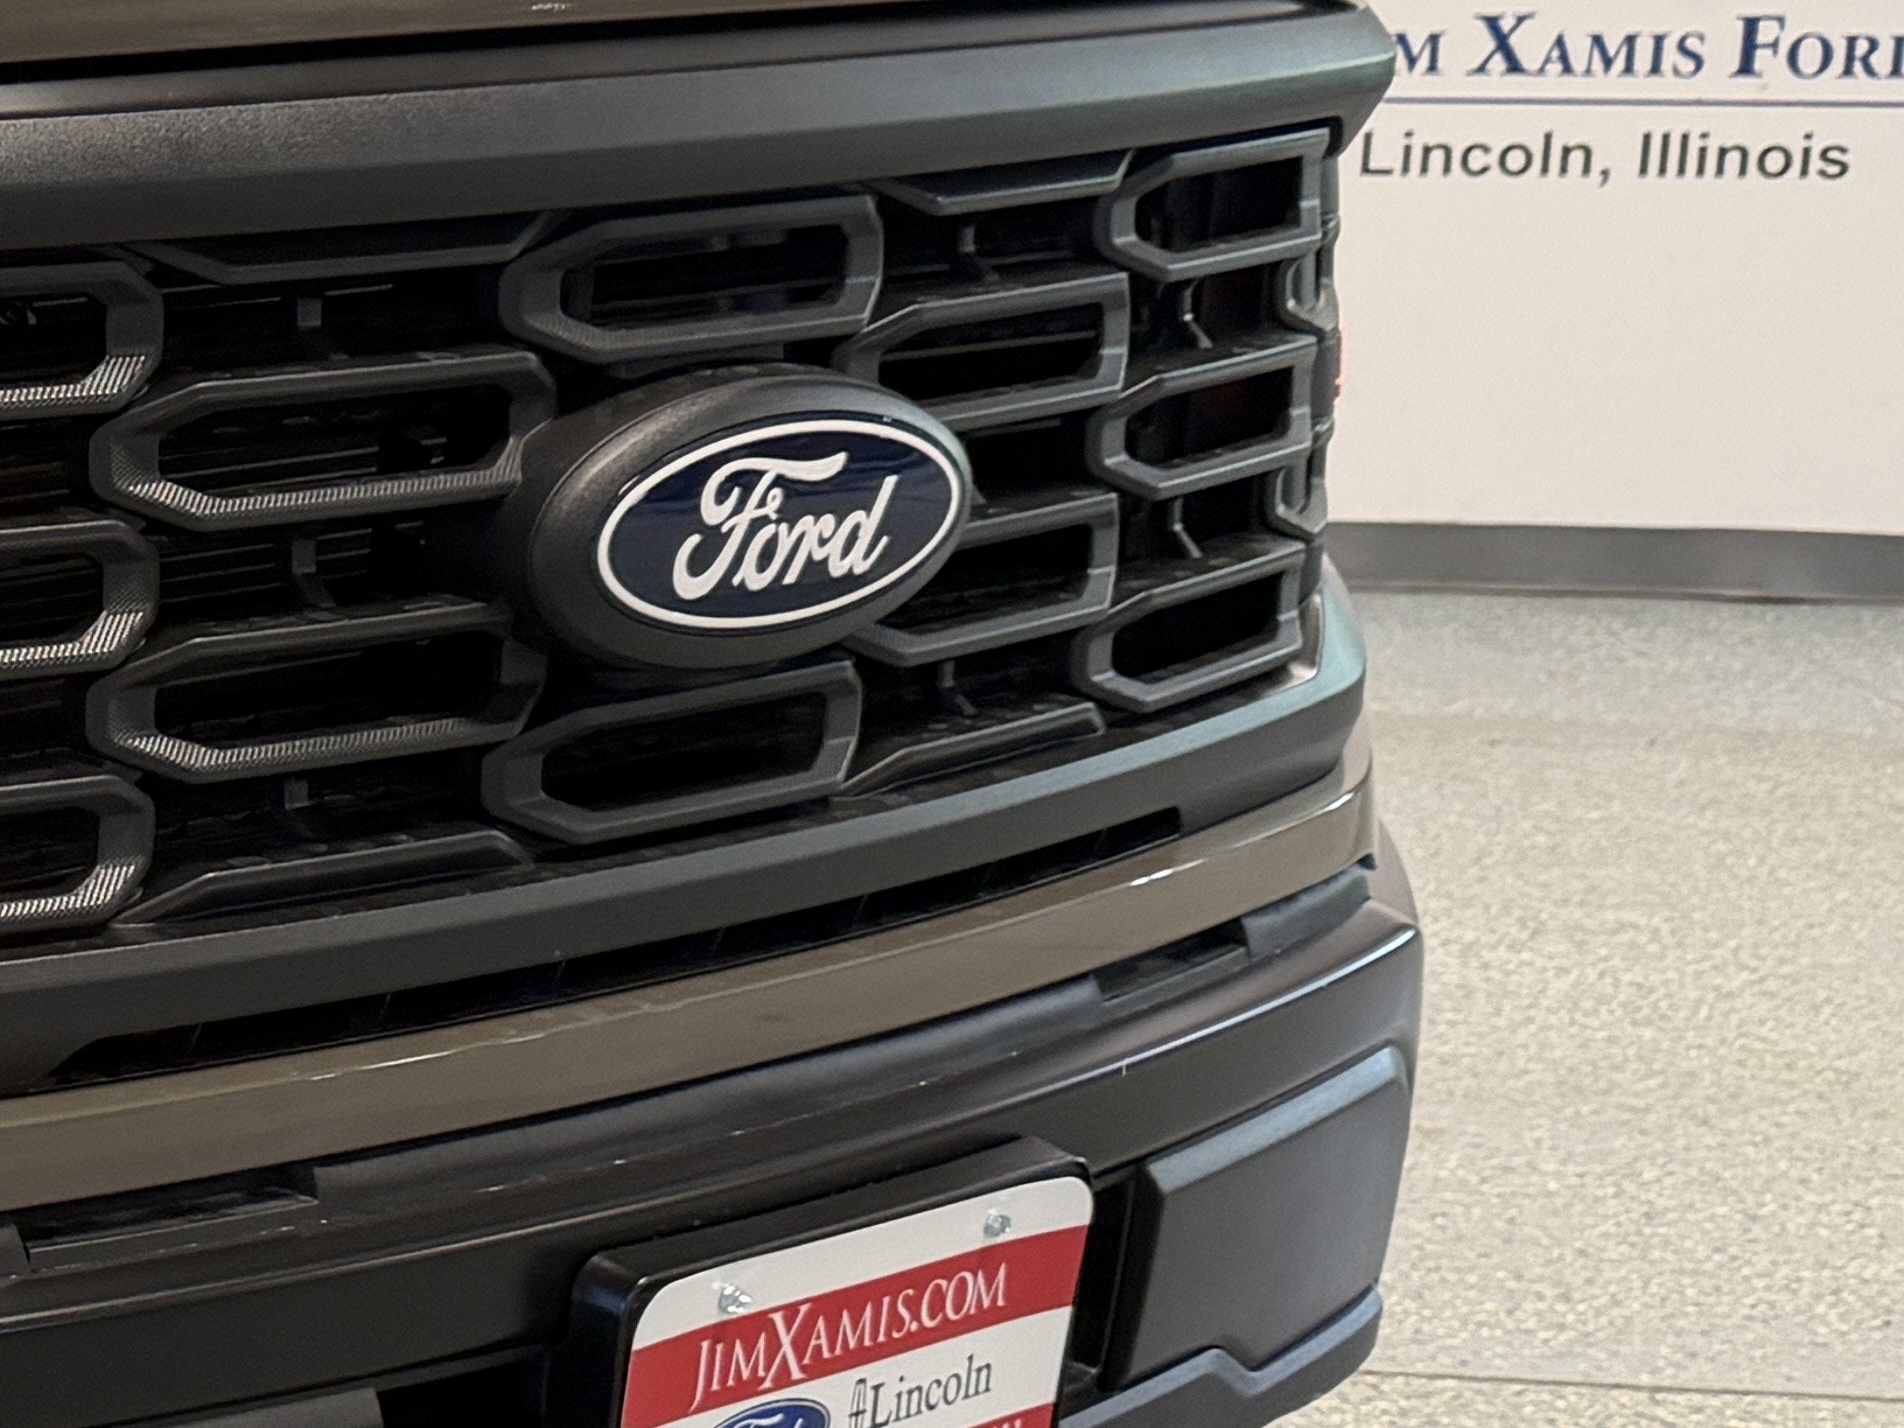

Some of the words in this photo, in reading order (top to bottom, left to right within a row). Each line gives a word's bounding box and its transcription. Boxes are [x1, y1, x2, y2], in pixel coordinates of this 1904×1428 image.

[1466, 12, 1706, 78] XAMIS
[1359, 129, 1611, 187] Lincoln,
[1637, 131, 1851, 180] Illinois
[673, 452, 898, 599] Ford
[690, 1262, 1008, 1412] JIMXAMIS.COM
